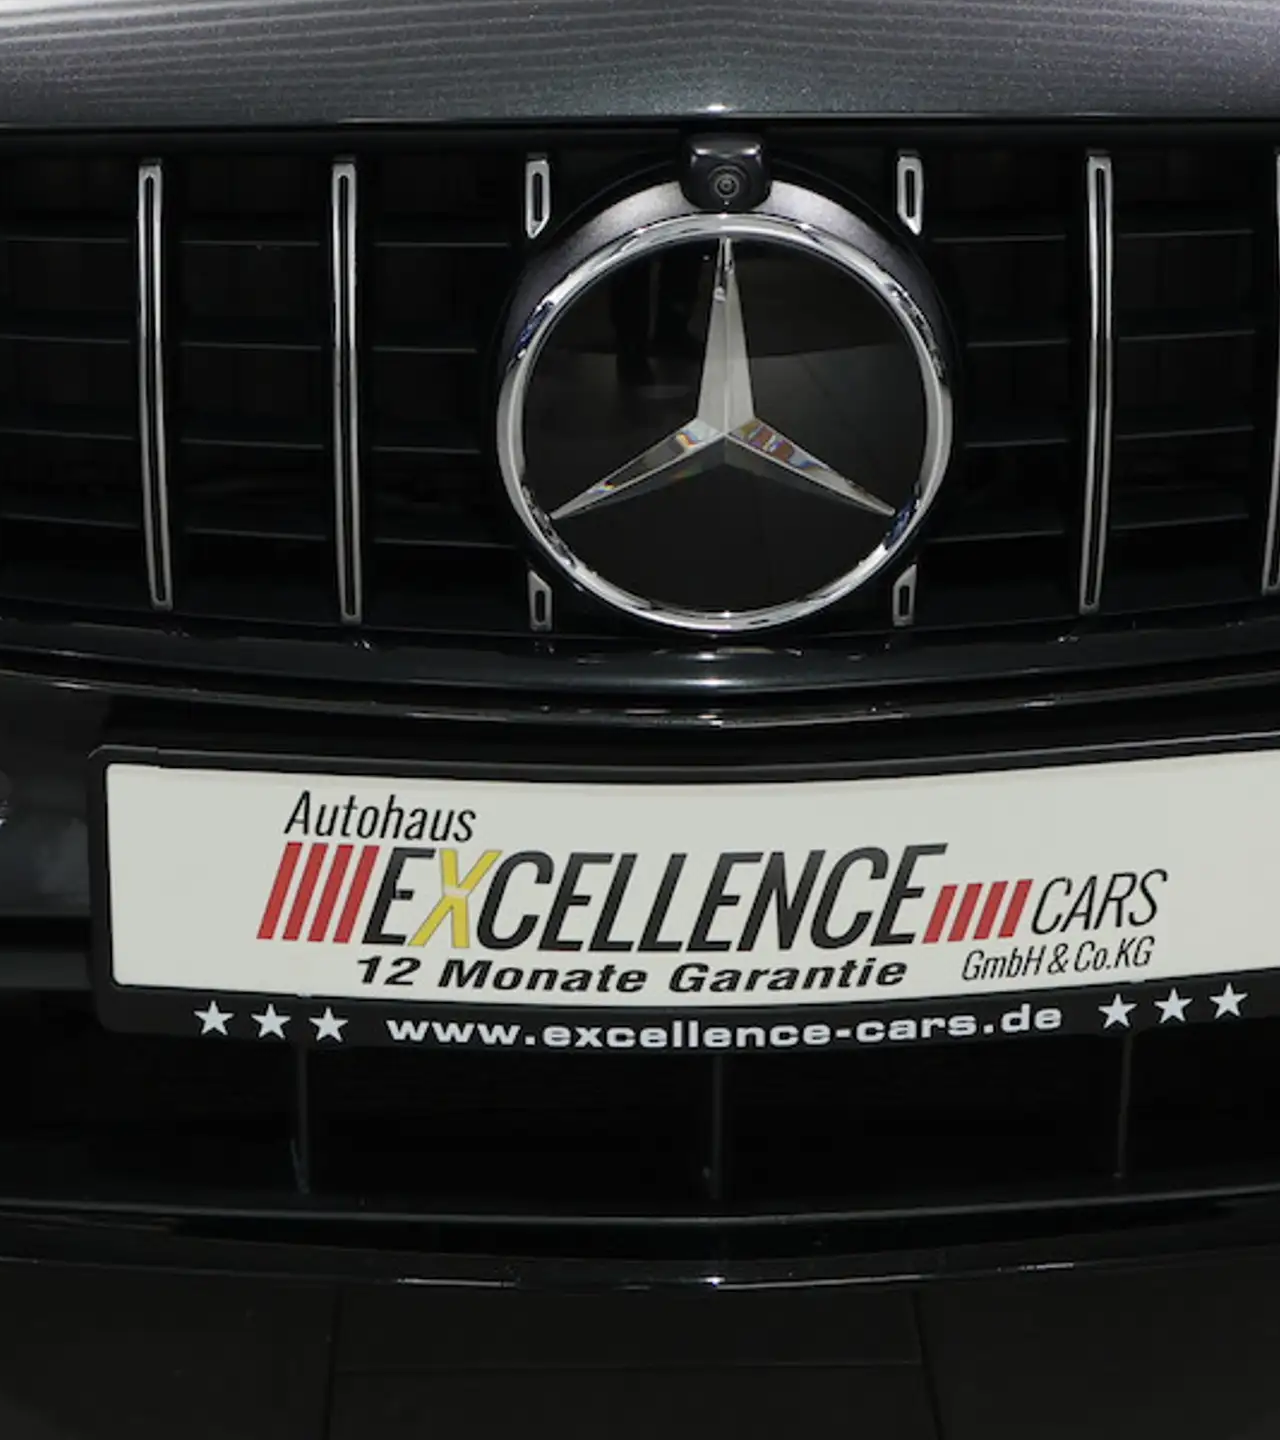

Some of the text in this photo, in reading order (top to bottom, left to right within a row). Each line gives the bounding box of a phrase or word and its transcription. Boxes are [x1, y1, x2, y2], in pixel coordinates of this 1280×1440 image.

[284, 789, 478, 843] Autohaus
[361, 842, 1168, 953] EXCELLENCE CARS
[356, 955, 908, 994] 12 Monate Garantie
[961, 944, 1047, 981] GmbH
[1047, 942, 1070, 975] &
[386, 1003, 1063, 1048] www.excellence-cars.de
